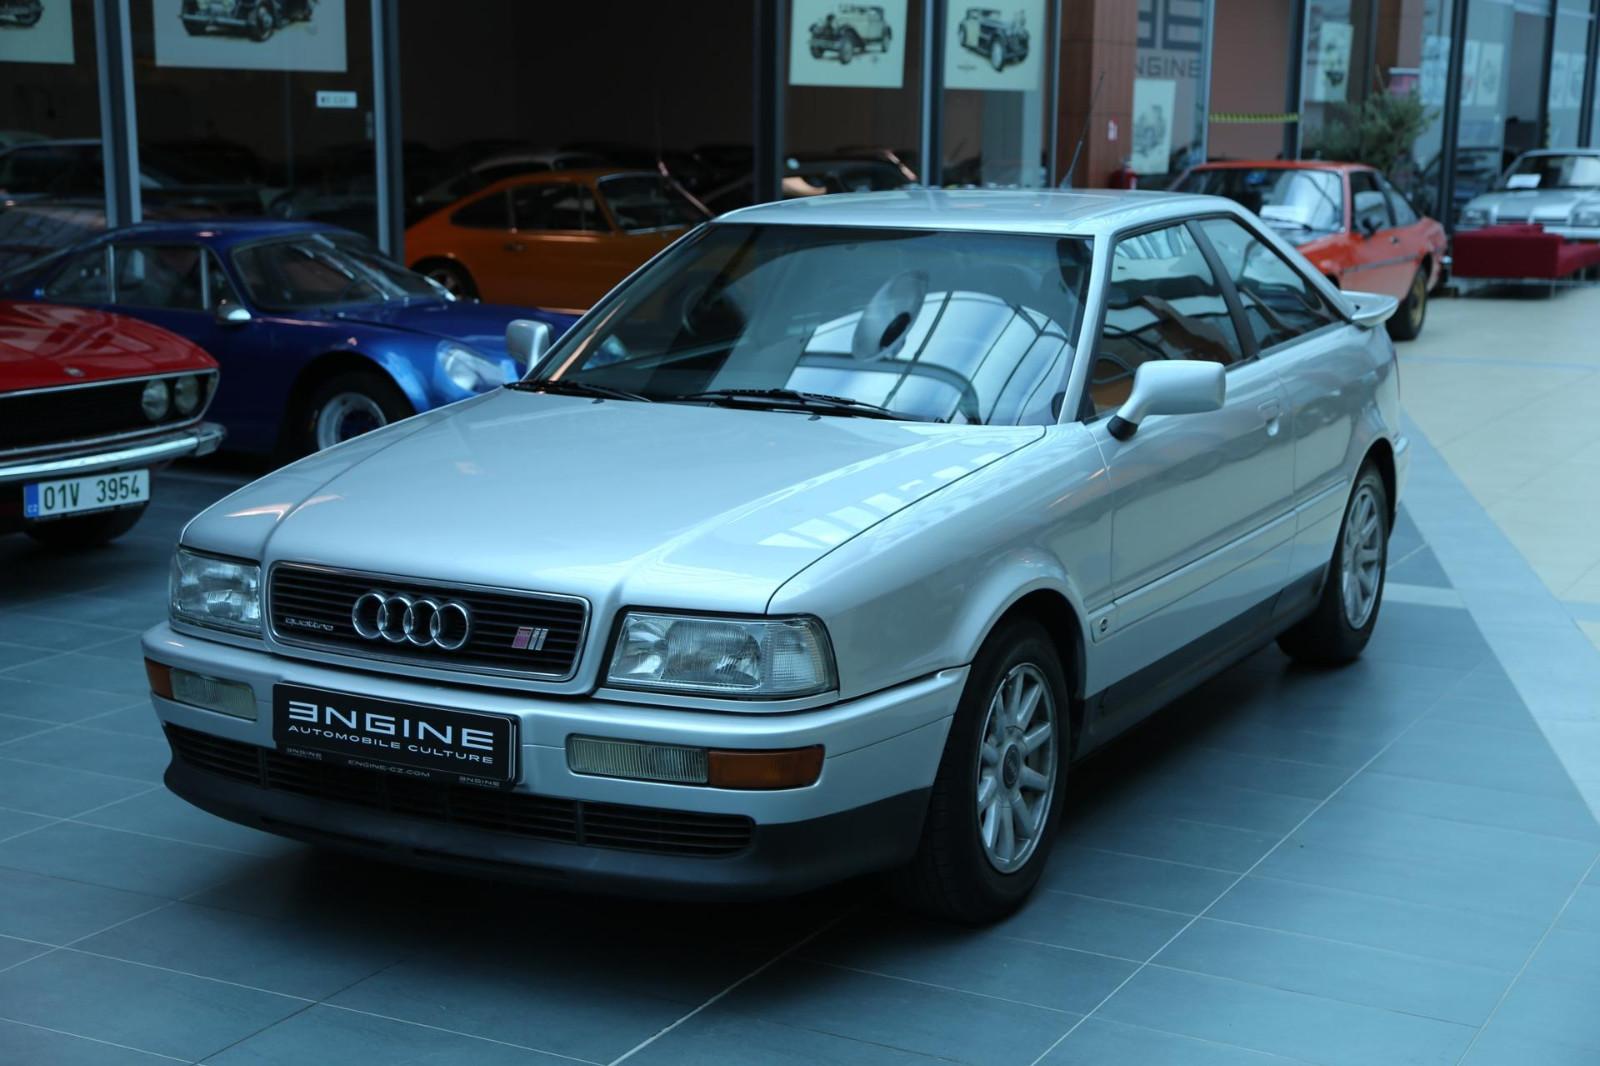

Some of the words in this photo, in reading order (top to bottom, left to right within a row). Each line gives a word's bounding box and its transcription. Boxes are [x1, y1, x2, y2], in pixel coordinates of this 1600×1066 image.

[44, 482, 80, 510] 01V
[96, 474, 140, 503] 3954
[285, 616, 334, 632] quattro
[287, 724, 401, 750] AUTOMOBILE
[407, 743, 493, 765] CULTURE
